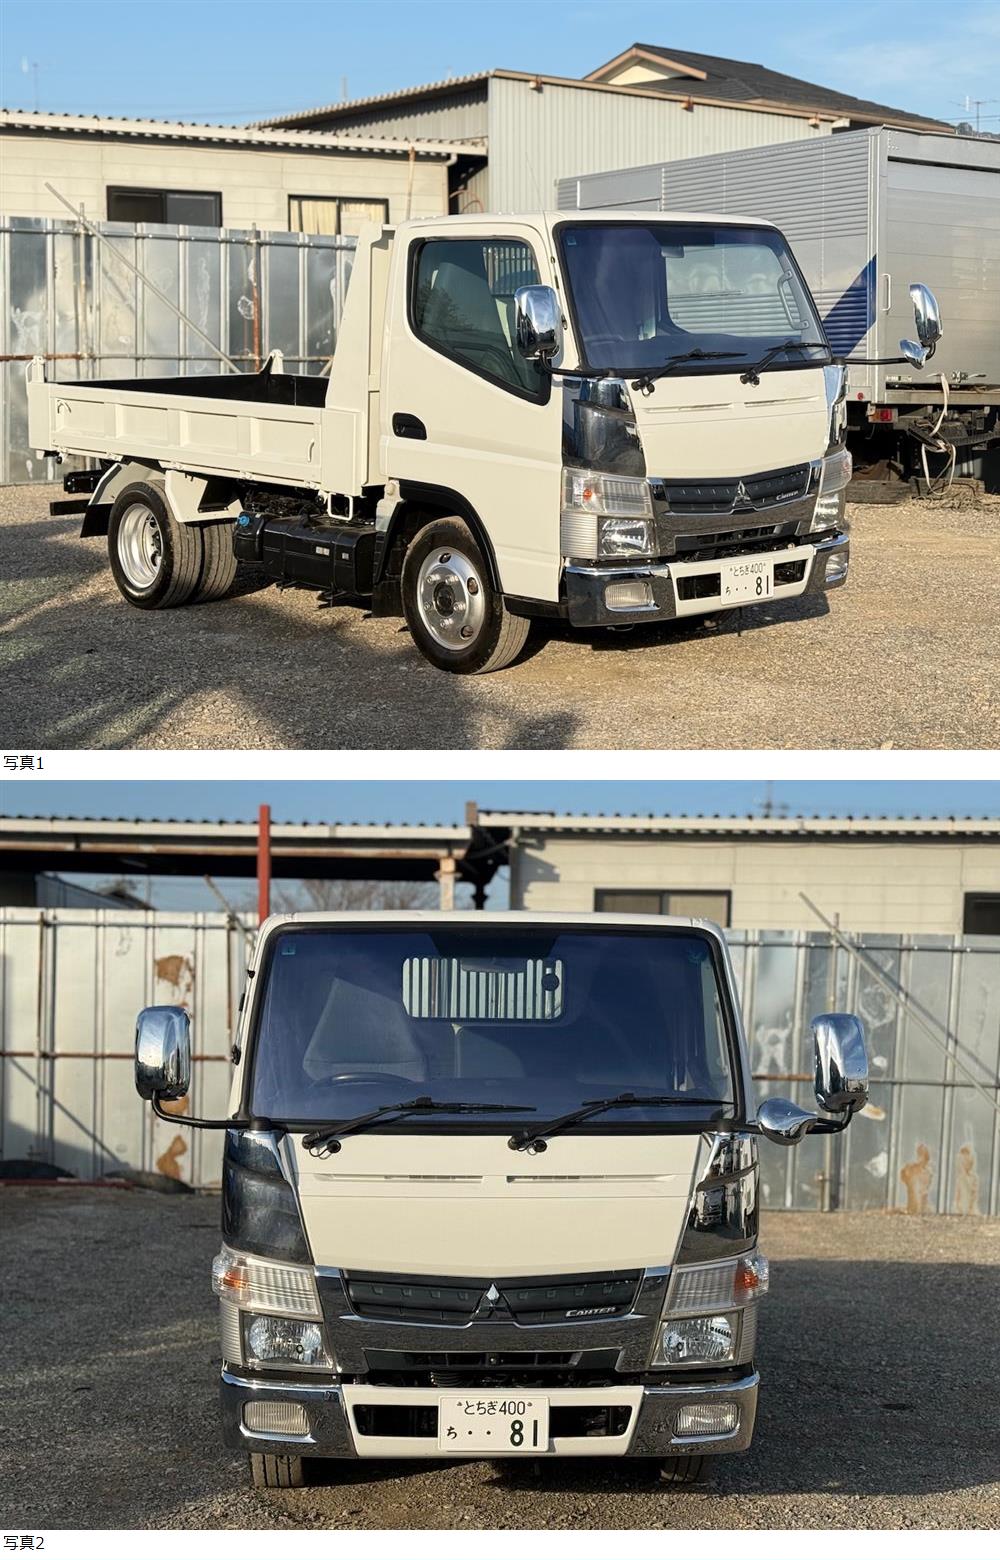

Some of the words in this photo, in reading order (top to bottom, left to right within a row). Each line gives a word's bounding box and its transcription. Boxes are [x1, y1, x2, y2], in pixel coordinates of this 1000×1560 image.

[565, 1306, 616, 1318] CANTER
[464, 1400, 526, 1415] とちぎ400
